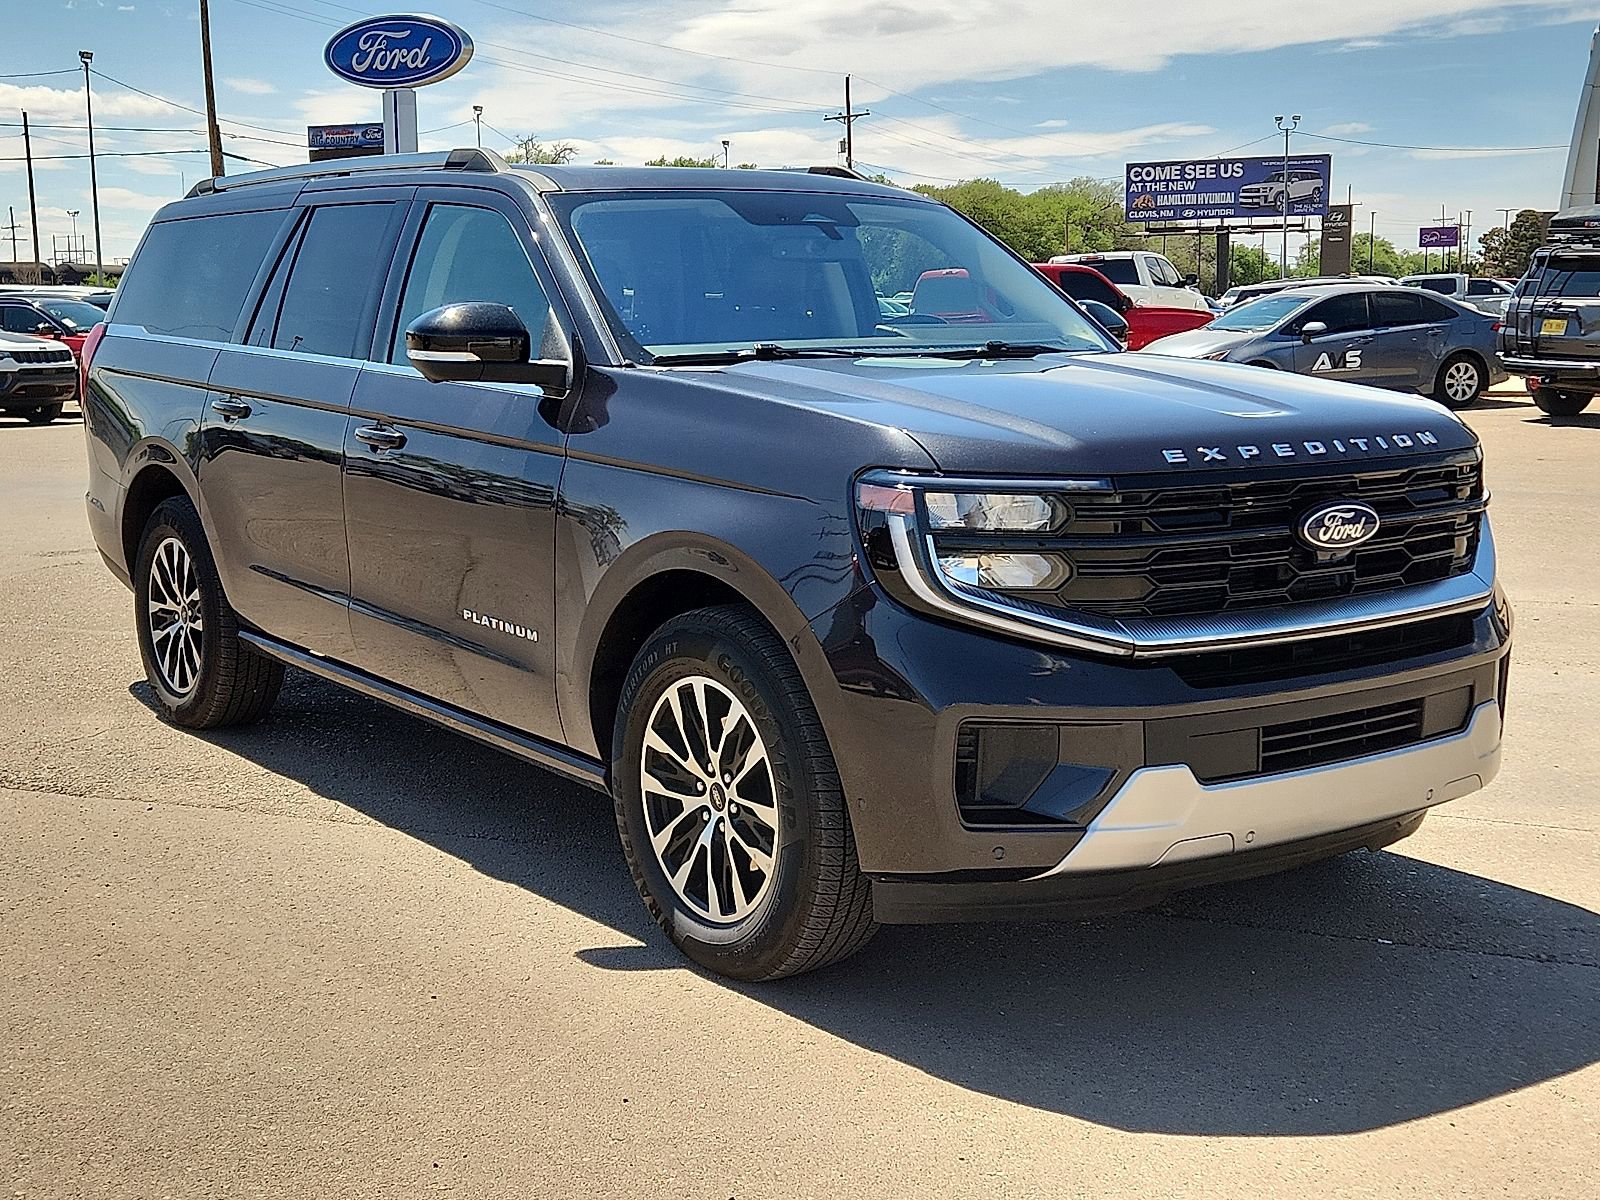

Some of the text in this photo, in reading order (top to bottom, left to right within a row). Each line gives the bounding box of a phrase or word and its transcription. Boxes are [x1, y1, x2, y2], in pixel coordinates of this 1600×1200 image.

[351, 29, 432, 73] Ford
[325, 135, 359, 146] COUNTRY
[365, 128, 383, 139] Ford
[1129, 162, 1244, 181] COME SEE US
[1129, 181, 1196, 193] AT THE NEW
[1156, 192, 1235, 206] HAMILTON HYUNDAI
[1128, 209, 1174, 219] CLOVIS, NM
[1197, 208, 1235, 216] HYUNDAI
[1161, 430, 1440, 464] EXPEDITION
[1317, 510, 1366, 541] Ford
[462, 608, 539, 642] PLATINUM
[664, 640, 679, 655] HT
